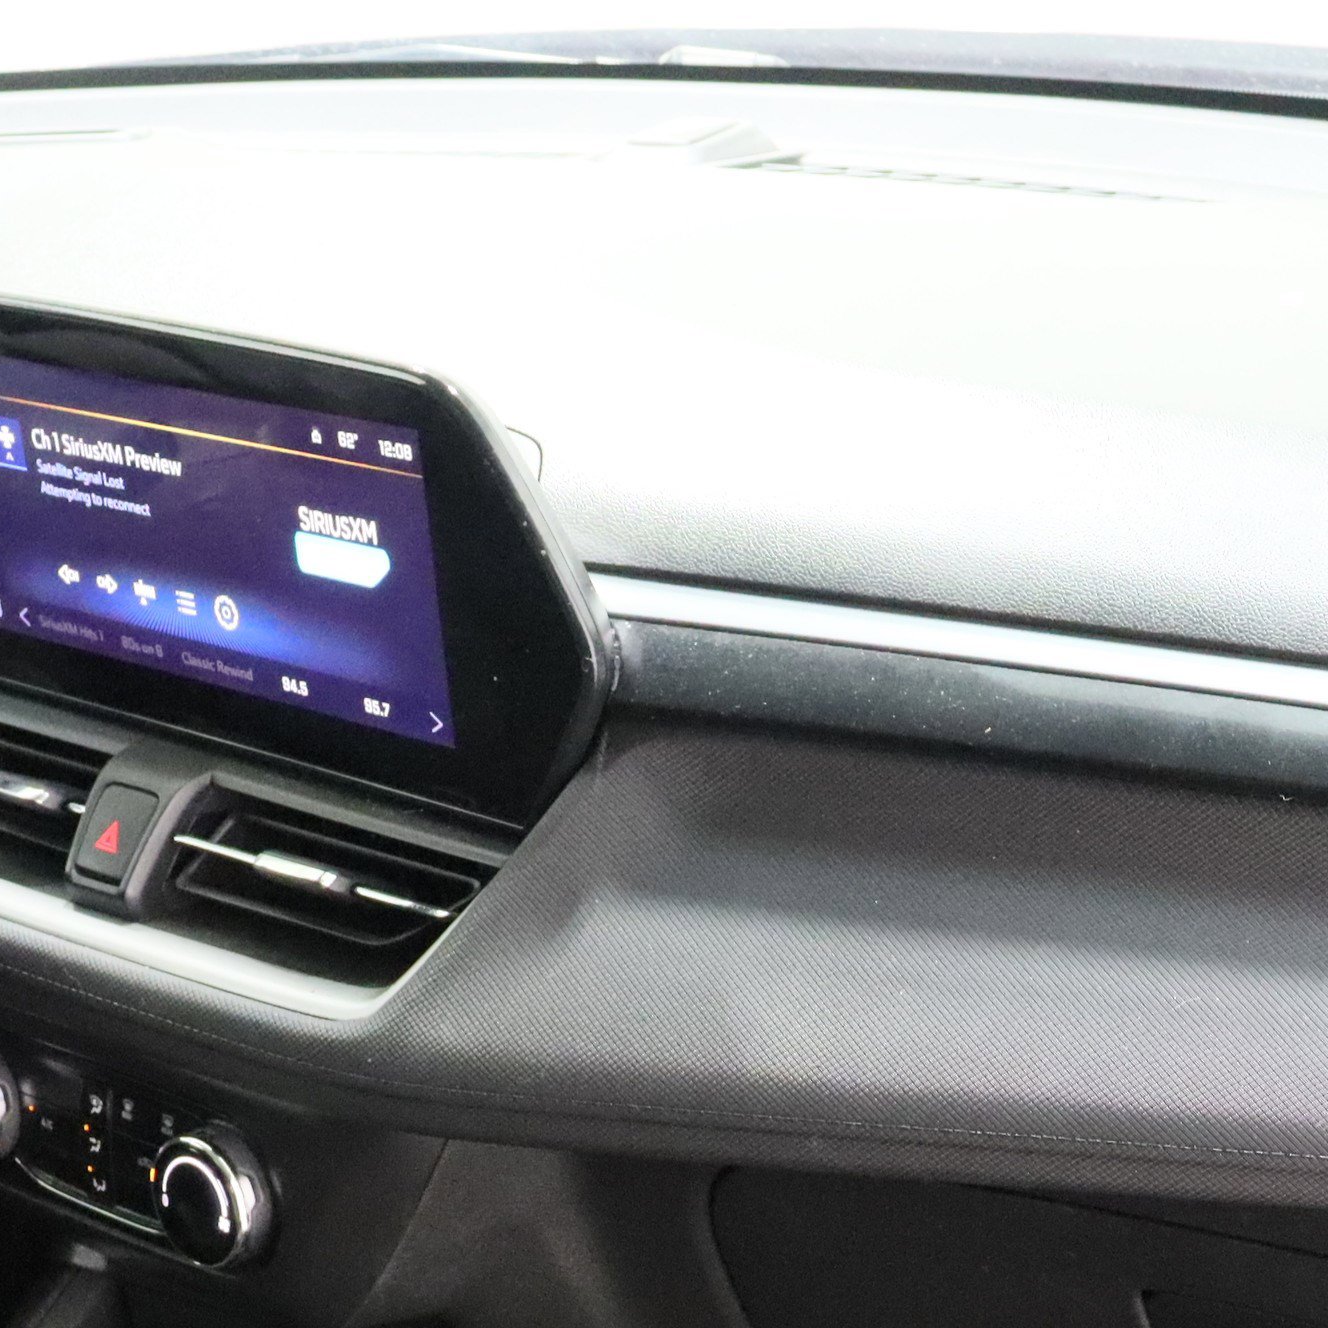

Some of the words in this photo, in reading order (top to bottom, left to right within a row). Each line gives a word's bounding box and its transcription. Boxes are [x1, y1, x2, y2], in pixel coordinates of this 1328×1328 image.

[31, 428, 50, 450] Ch
[51, 432, 60, 453] 1
[61, 433, 124, 465] SiriusXM
[125, 445, 182, 477] Preview
[36, 458, 73, 480] Satellite
[72, 466, 102, 487] Signal
[103, 473, 125, 490] Lost
[40, 480, 91, 508] Attempting
[91, 492, 102, 508] to
[103, 496, 151, 517] reconnect
[298, 505, 378, 546] SIRIUSXM
